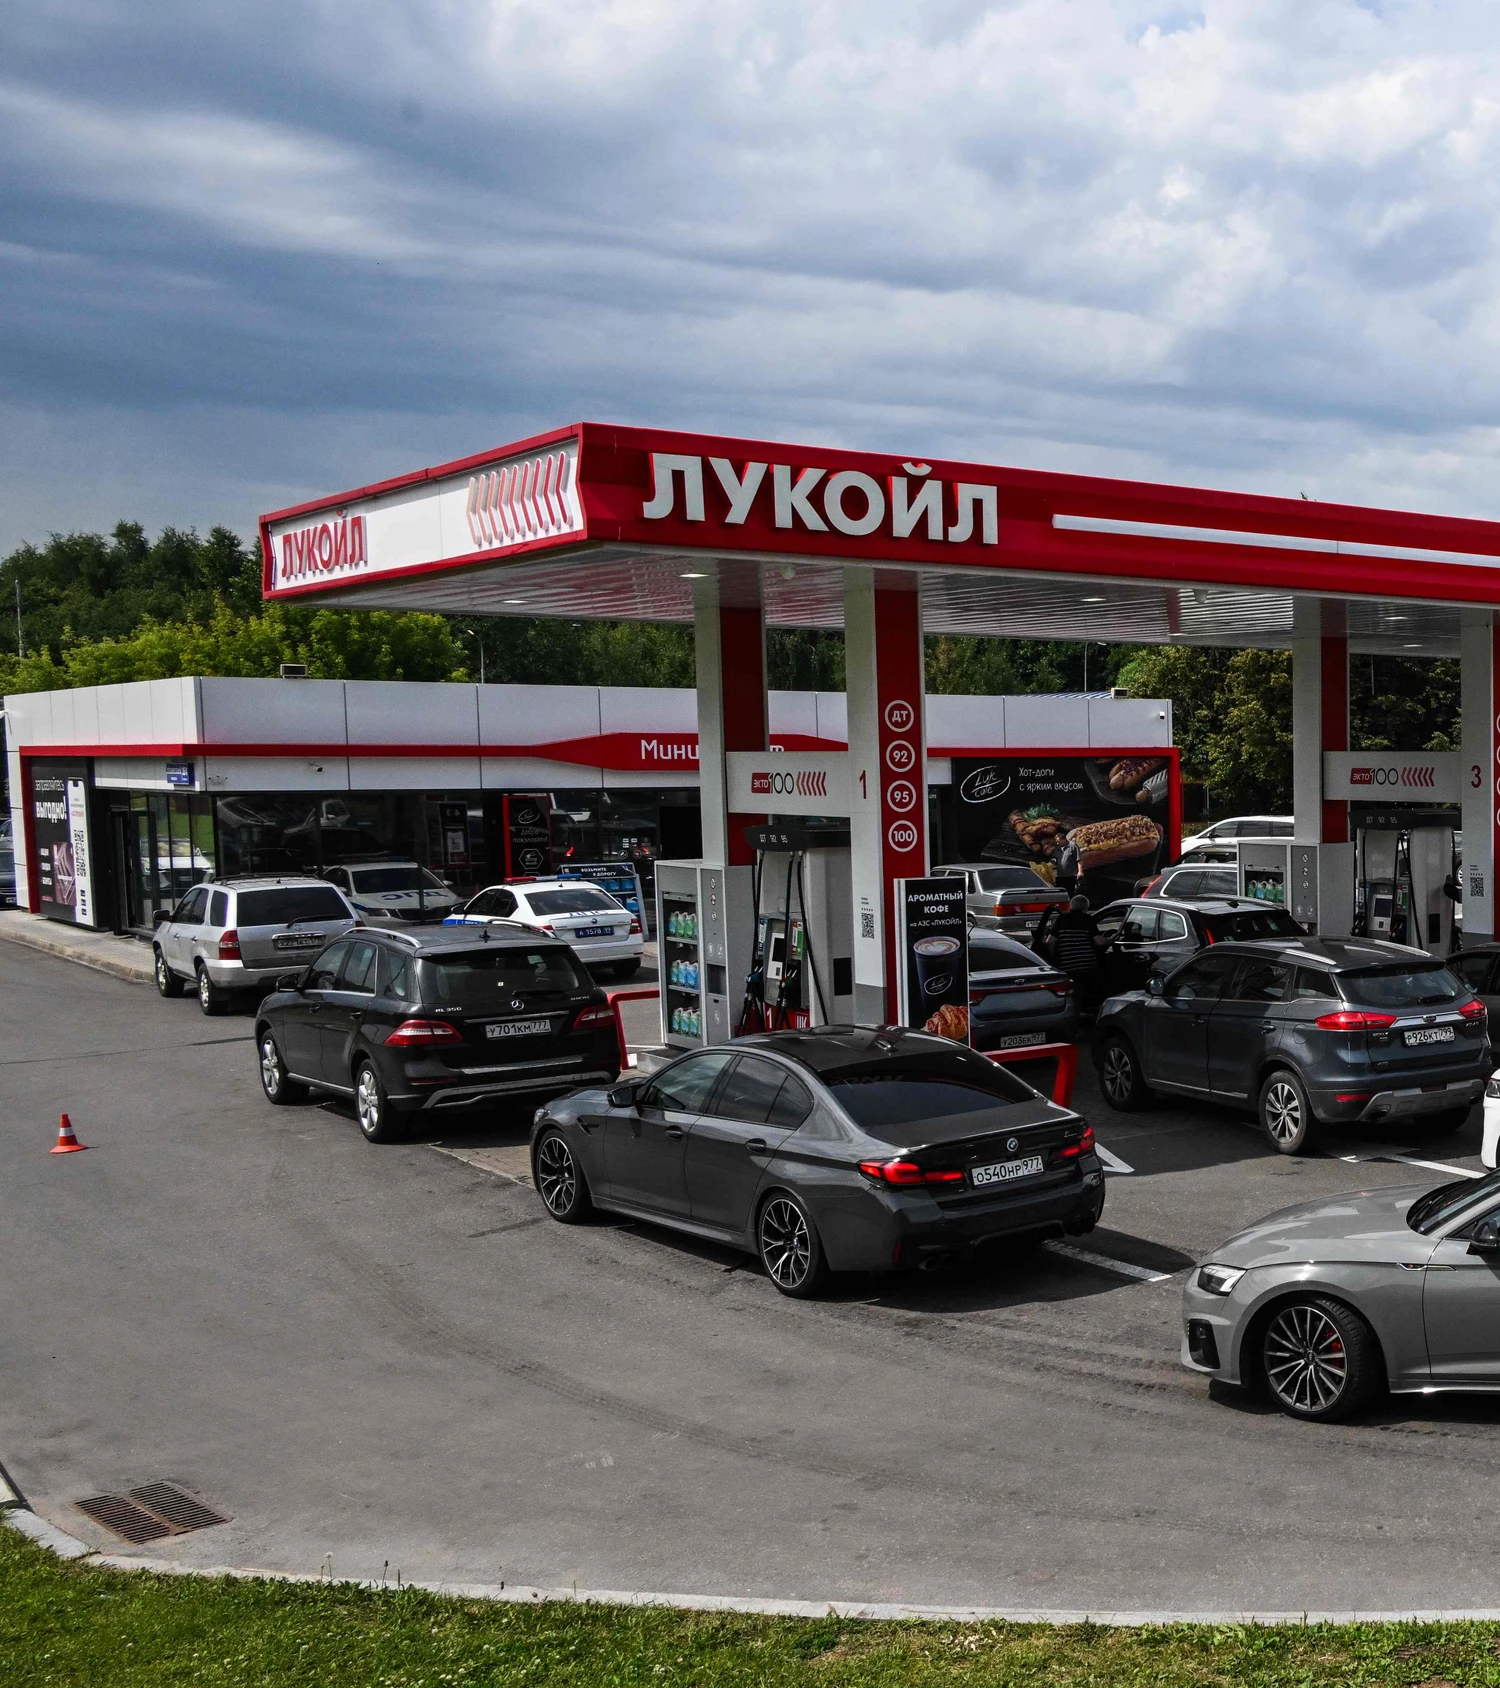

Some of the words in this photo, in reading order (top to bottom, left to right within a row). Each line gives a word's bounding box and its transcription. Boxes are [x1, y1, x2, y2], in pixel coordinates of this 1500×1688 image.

[643, 451, 998, 544] ЛУКОЙЛ
[281, 508, 364, 578] ЛУКОЙЛ
[891, 710, 908, 723] ДТ
[893, 750, 908, 762] 92
[1018, 767, 1054, 778] Хот-доги
[1470, 764, 1482, 788] 3
[859, 769, 867, 800] 1
[1026, 782, 1052, 793] ярким
[1054, 782, 1083, 791] вкусом
[893, 791, 909, 803] 95
[893, 830, 913, 843] 100
[907, 890, 963, 902] АРОМАТНЫЙ
[924, 904, 950, 914] КОФЕ
[917, 919, 930, 927] АЗС
[488, 1023, 532, 1036] У701КМ
[1406, 1031, 1438, 1043] Р926КТ
[976, 1164, 1022, 1183] О540НР
[1022, 1157, 1040, 1170] 977
